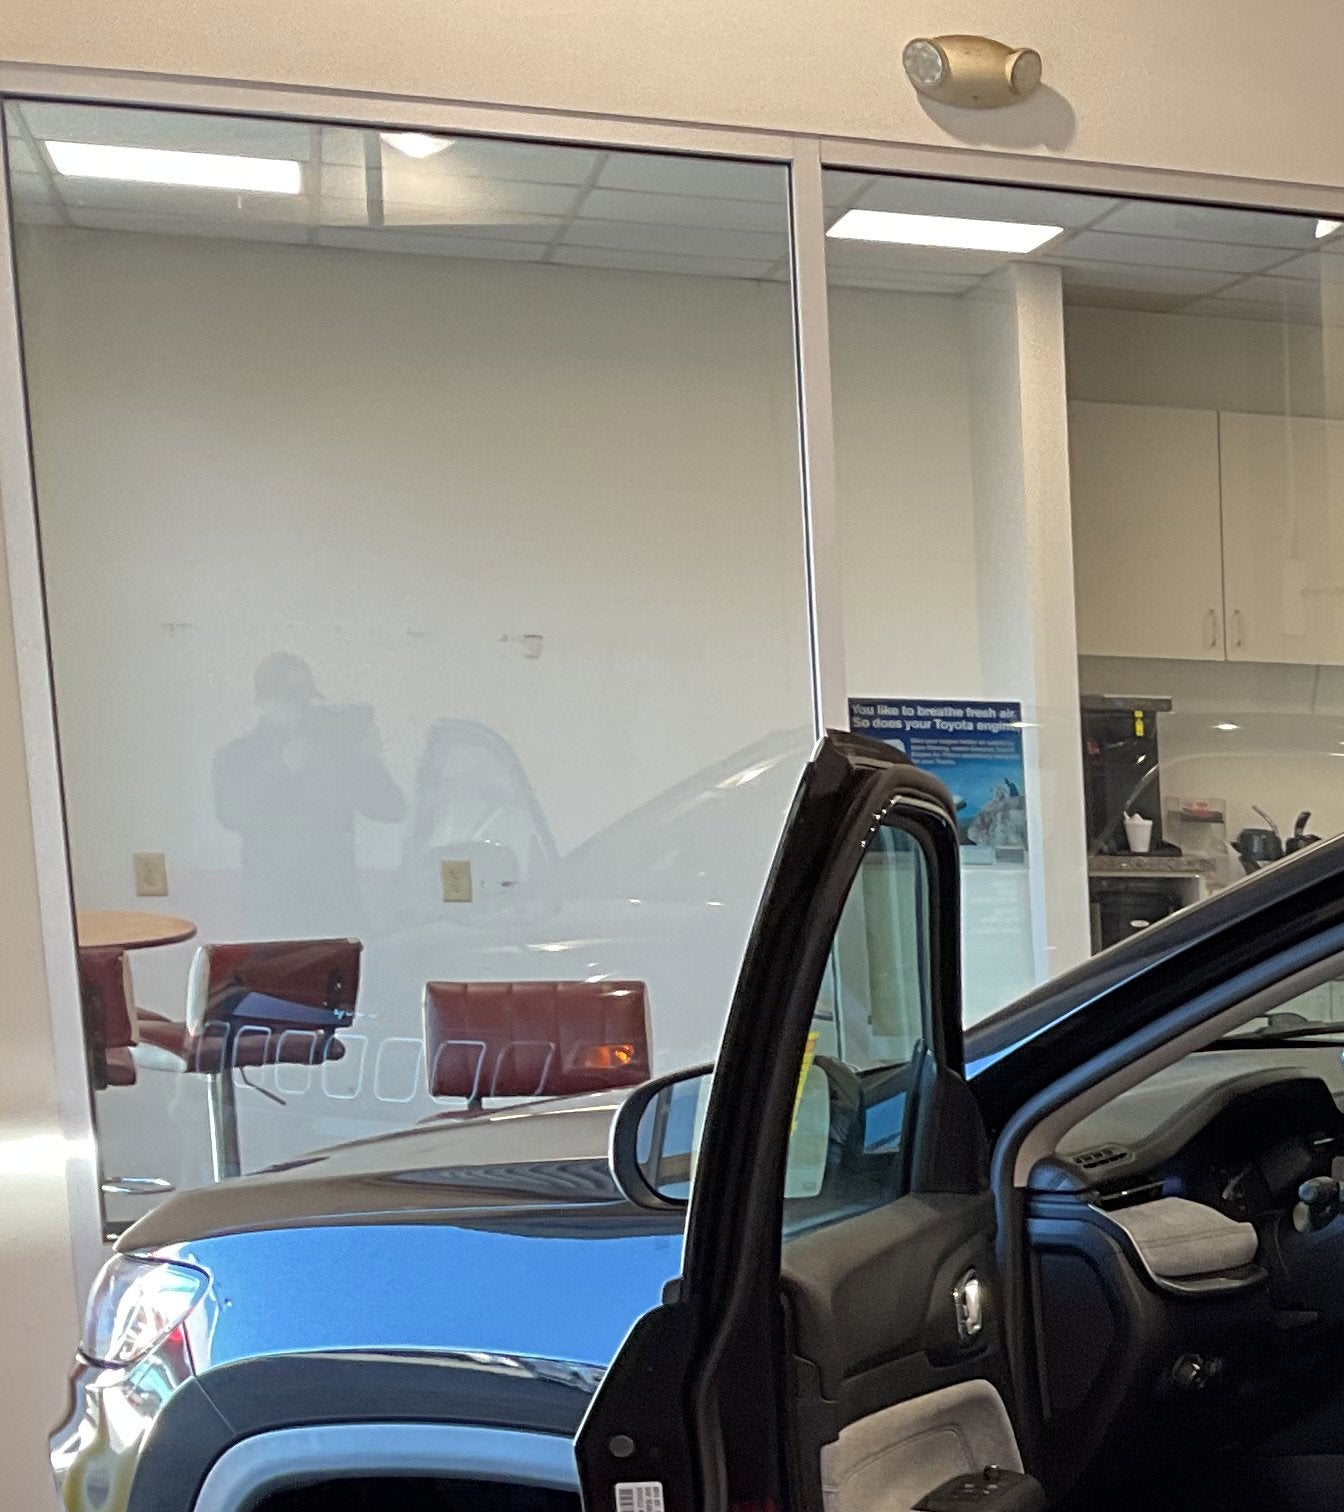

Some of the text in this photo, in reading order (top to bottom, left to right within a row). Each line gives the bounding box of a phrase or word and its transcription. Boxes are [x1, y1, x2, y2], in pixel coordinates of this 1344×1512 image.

[852, 704, 874, 716] You
[877, 704, 899, 716] like
[902, 706, 915, 717] to
[917, 706, 964, 718] breathe
[966, 707, 997, 719] fresh
[853, 717, 870, 729] So
[873, 718, 902, 729] does
[904, 720, 932, 731] your
[933, 719, 974, 732] Toyota
